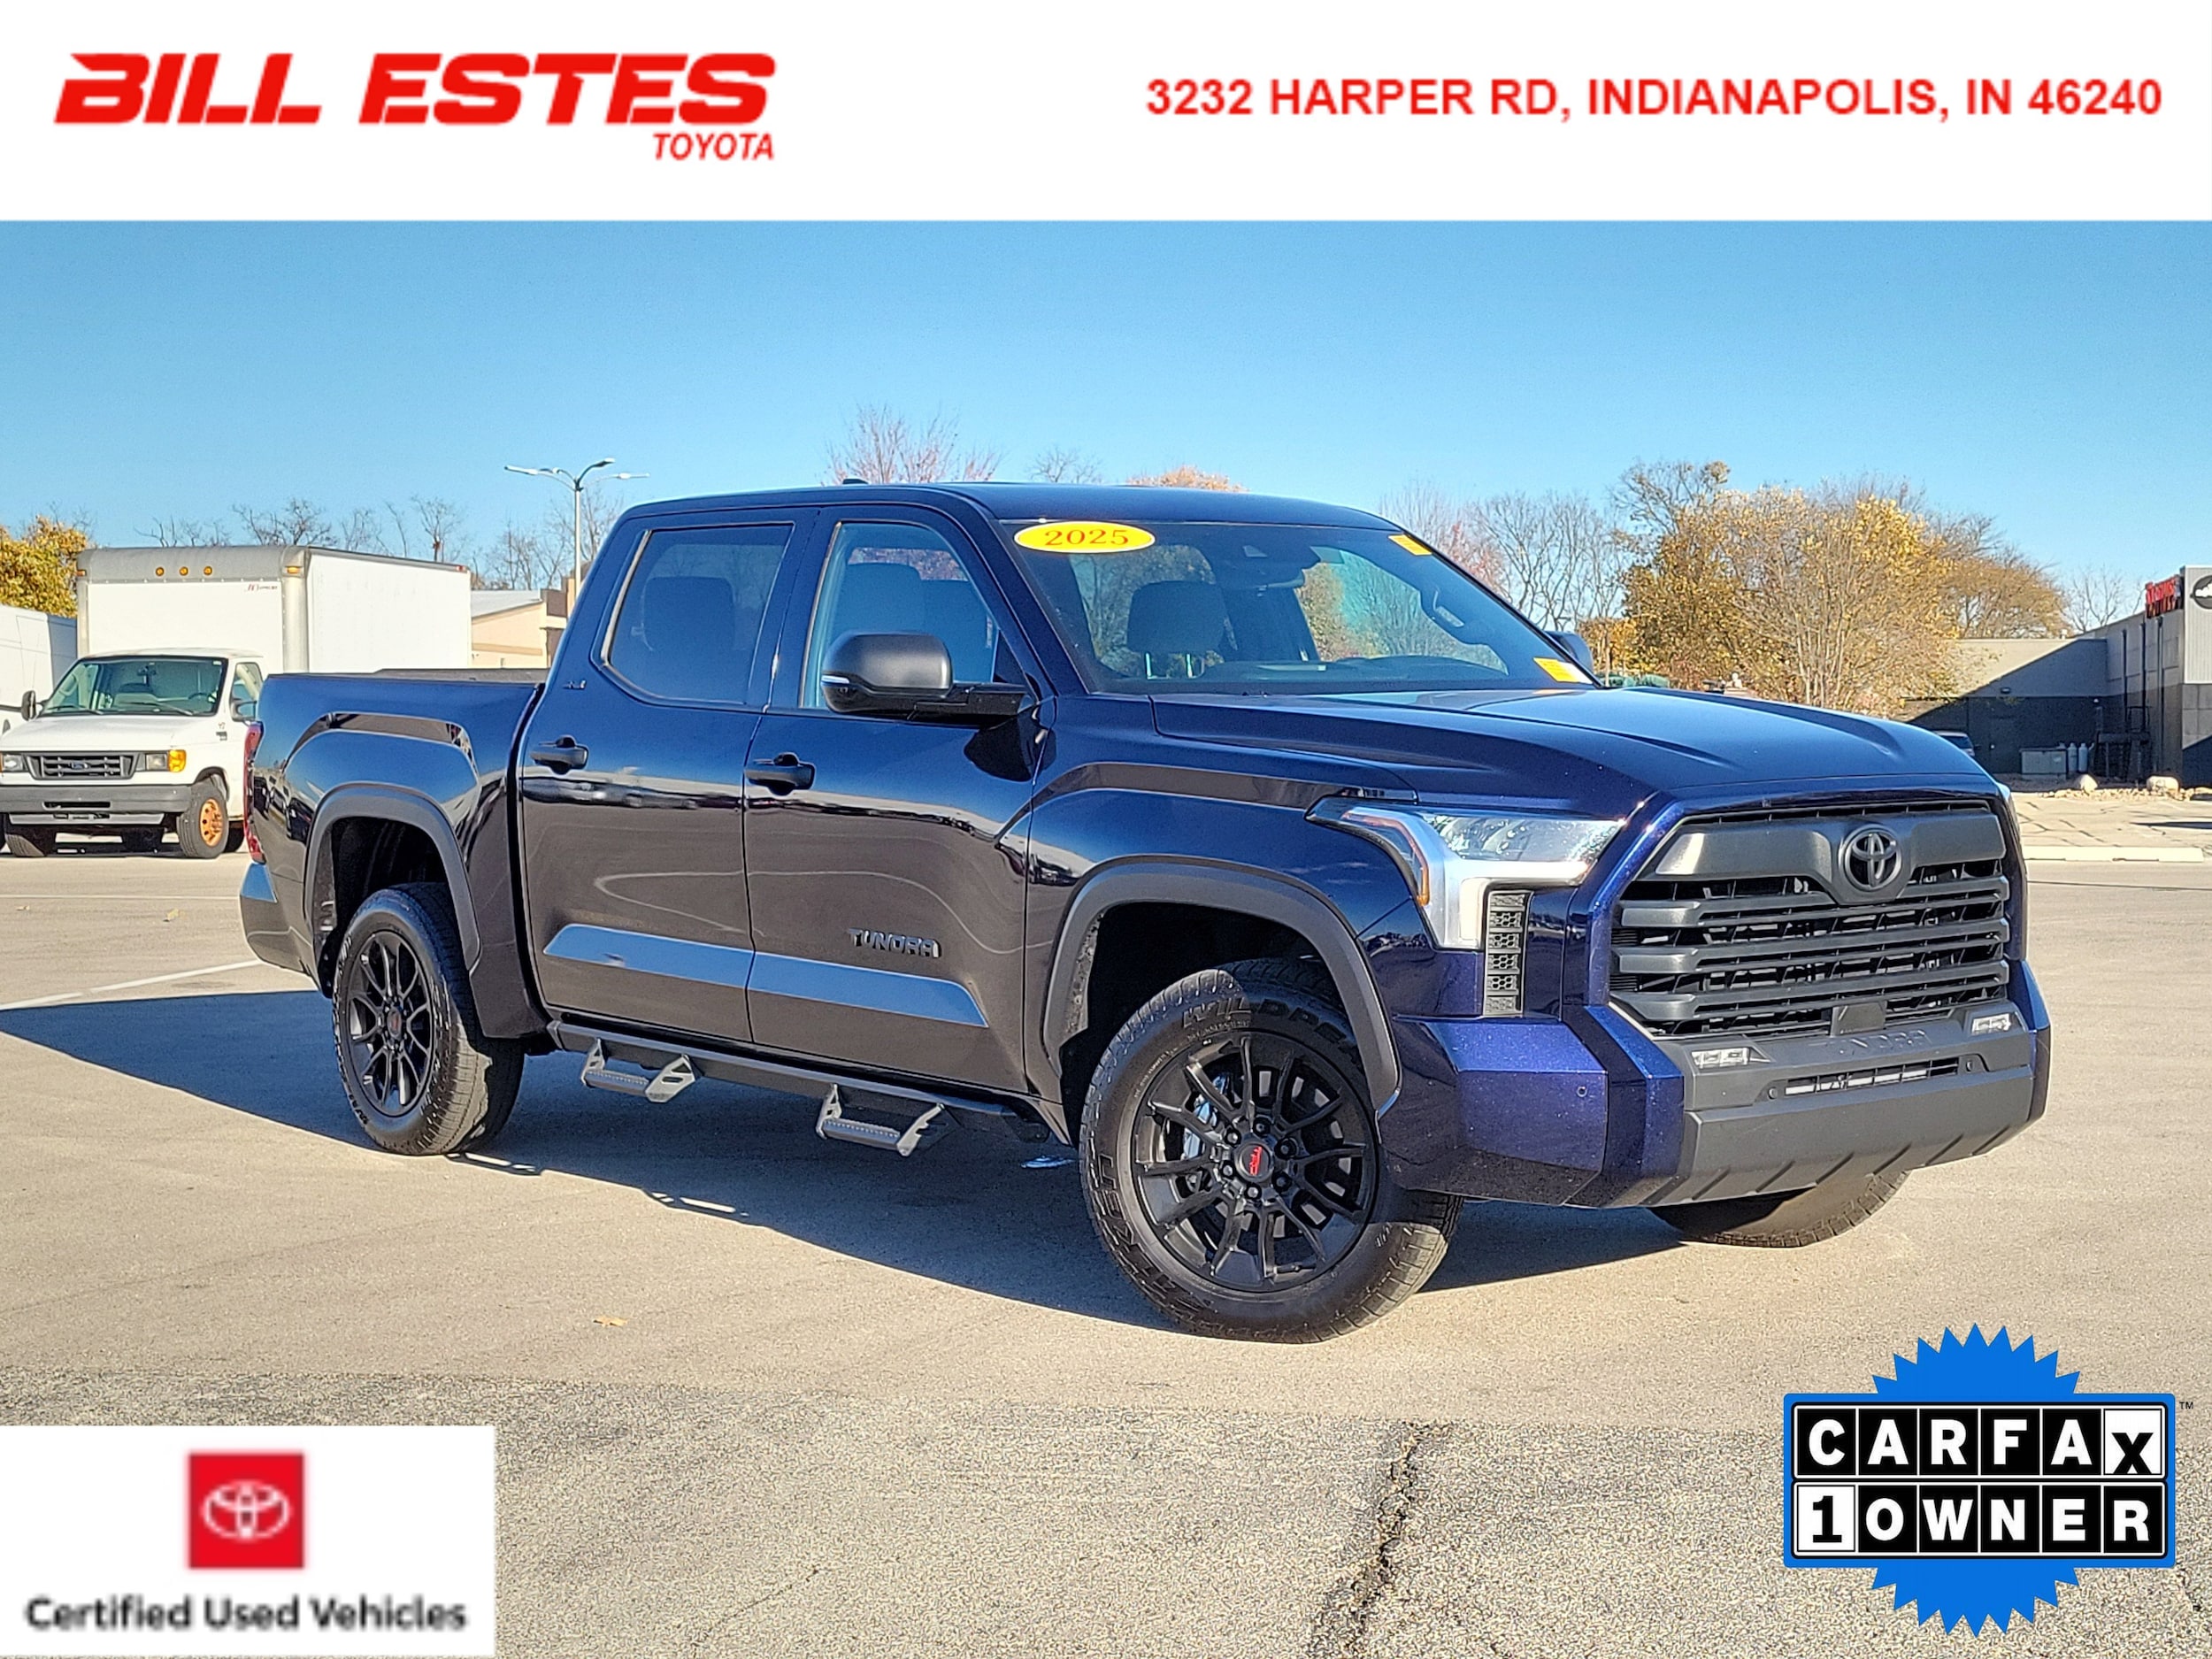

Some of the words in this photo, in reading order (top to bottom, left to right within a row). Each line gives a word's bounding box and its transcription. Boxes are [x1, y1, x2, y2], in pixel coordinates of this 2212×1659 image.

[1044, 529, 1129, 546] 2025
[849, 927, 941, 958] TUNDRA
[1182, 996, 1366, 1069] WILDPEA
[1808, 1029, 1932, 1056] NDRA
